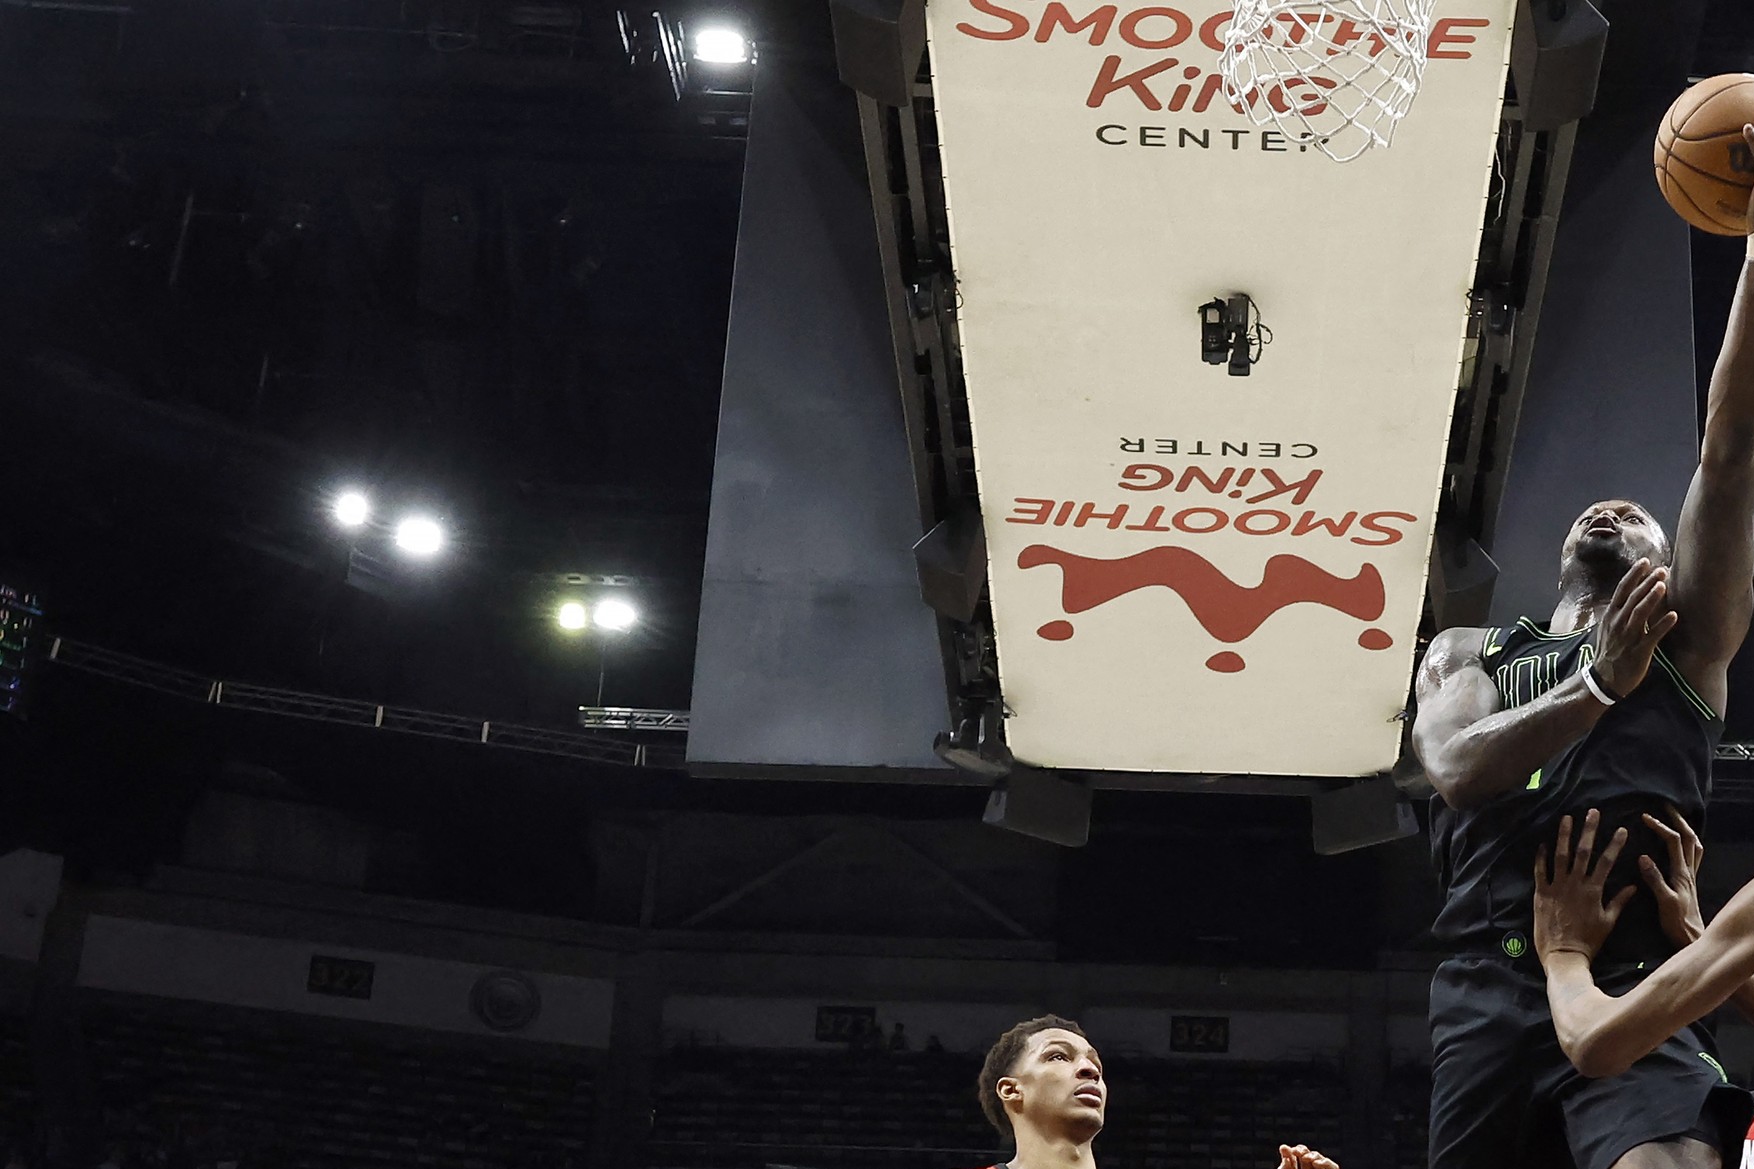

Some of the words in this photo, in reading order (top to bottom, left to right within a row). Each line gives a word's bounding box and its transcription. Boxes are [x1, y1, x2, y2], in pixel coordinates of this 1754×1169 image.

[957, 0, 1490, 60] SMOOTHE
[1119, 436, 1318, 459] CENTER
[1118, 463, 1324, 506] KiNG
[1005, 497, 1418, 547] SMOOTHIE
